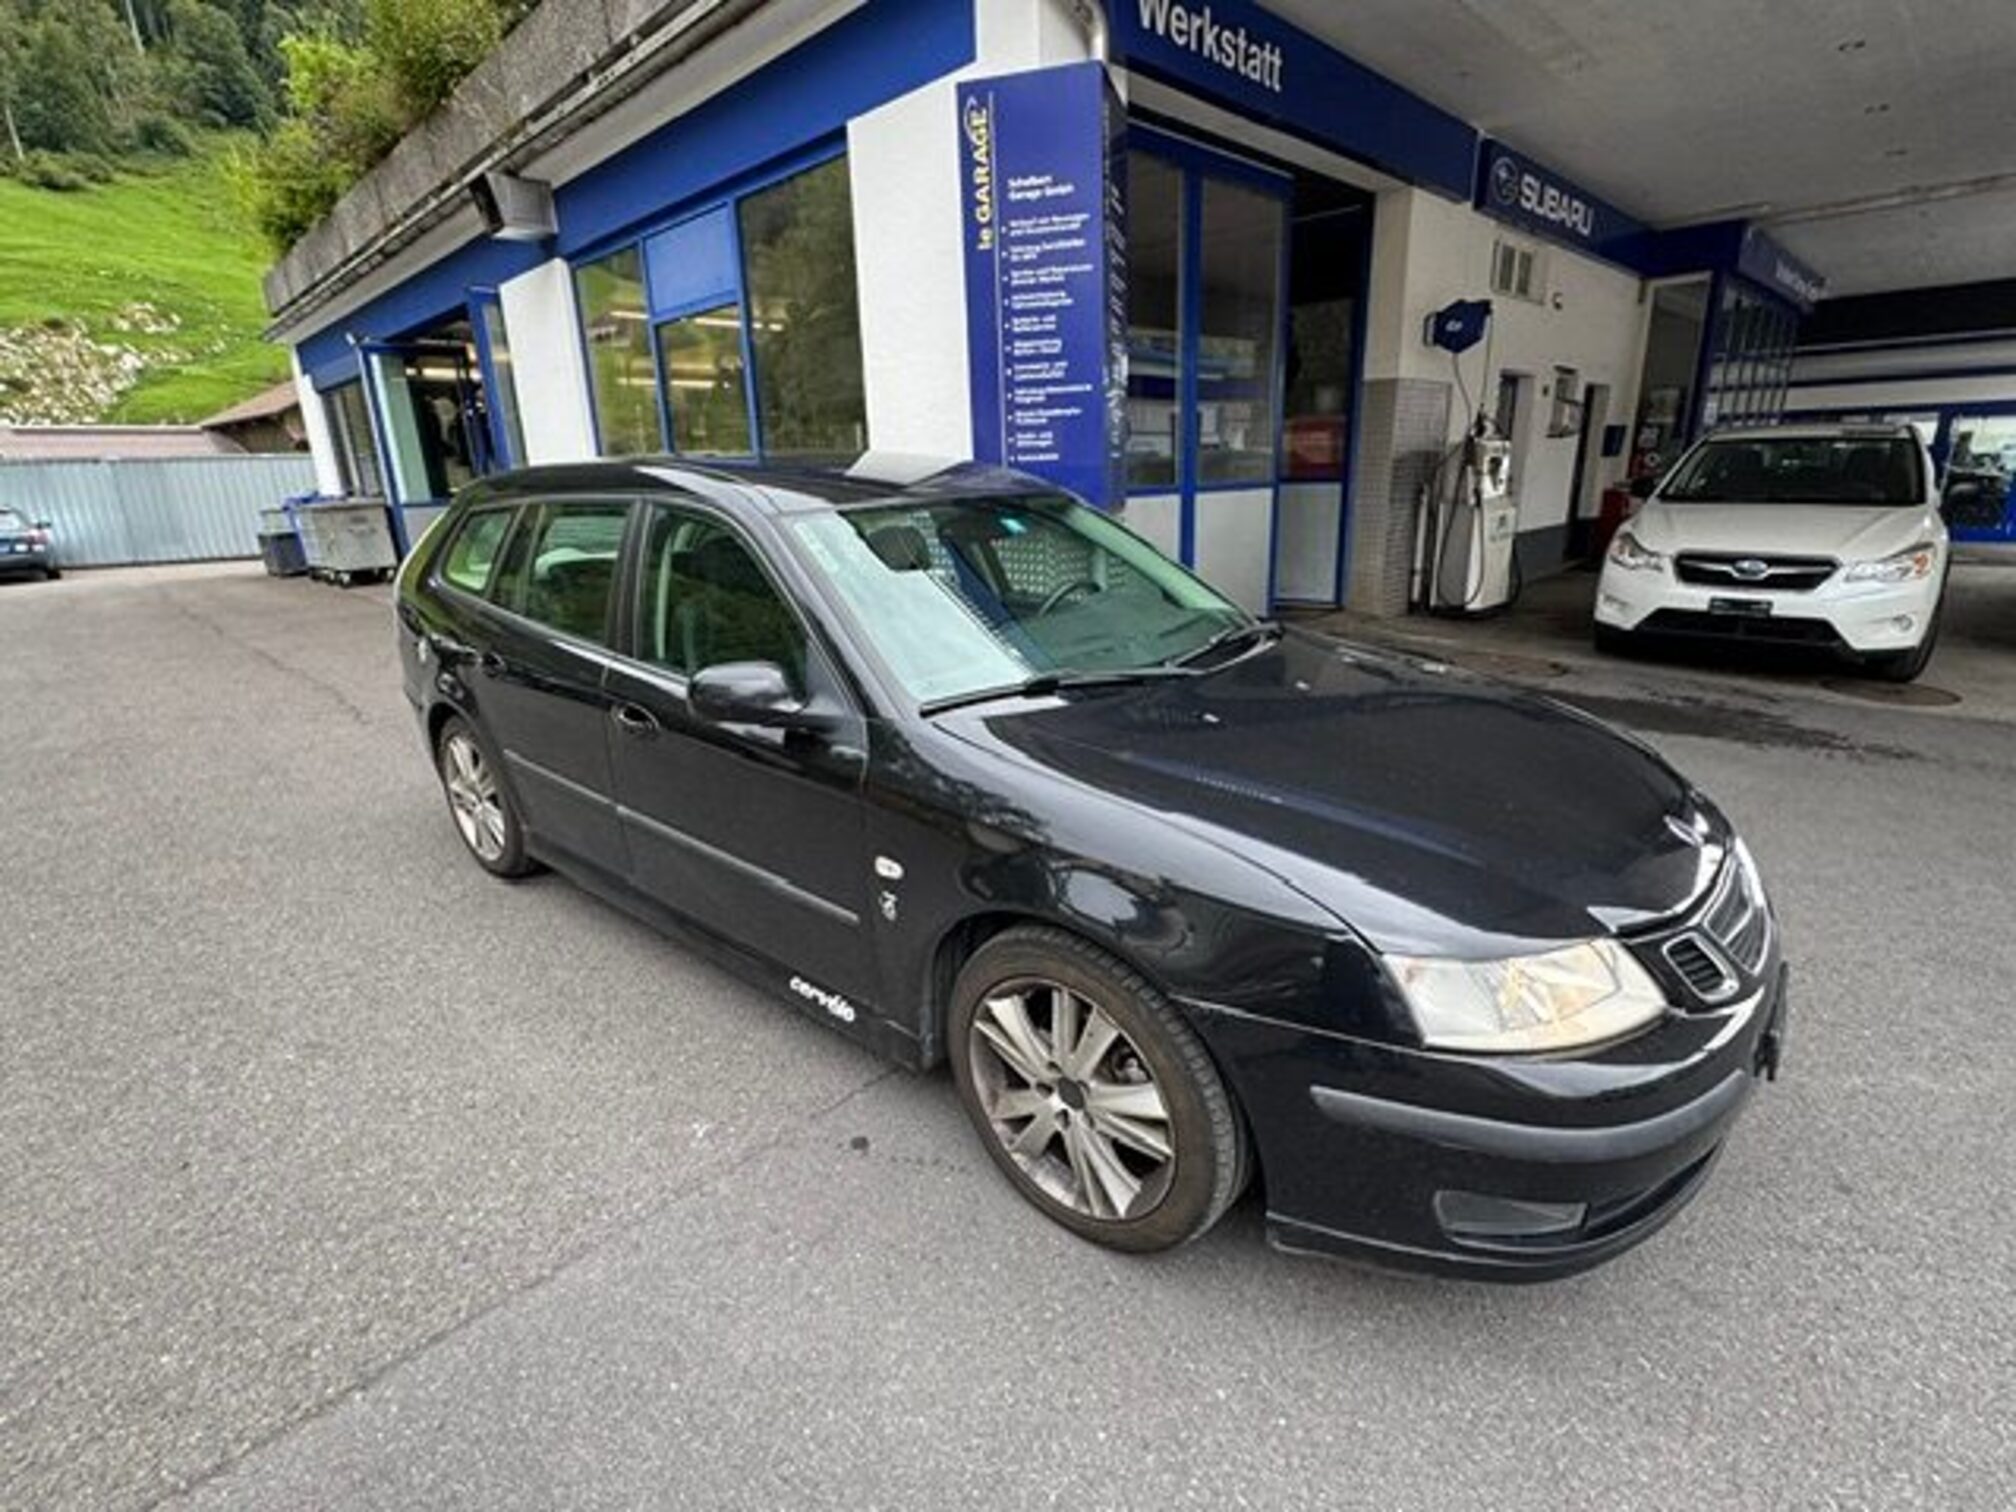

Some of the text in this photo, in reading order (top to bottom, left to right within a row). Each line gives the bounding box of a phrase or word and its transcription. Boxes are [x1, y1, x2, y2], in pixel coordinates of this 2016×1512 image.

[1139, 0, 1283, 92] Werkstatt
[969, 107, 992, 223] GARAGE
[1519, 173, 1595, 237] SUBARU
